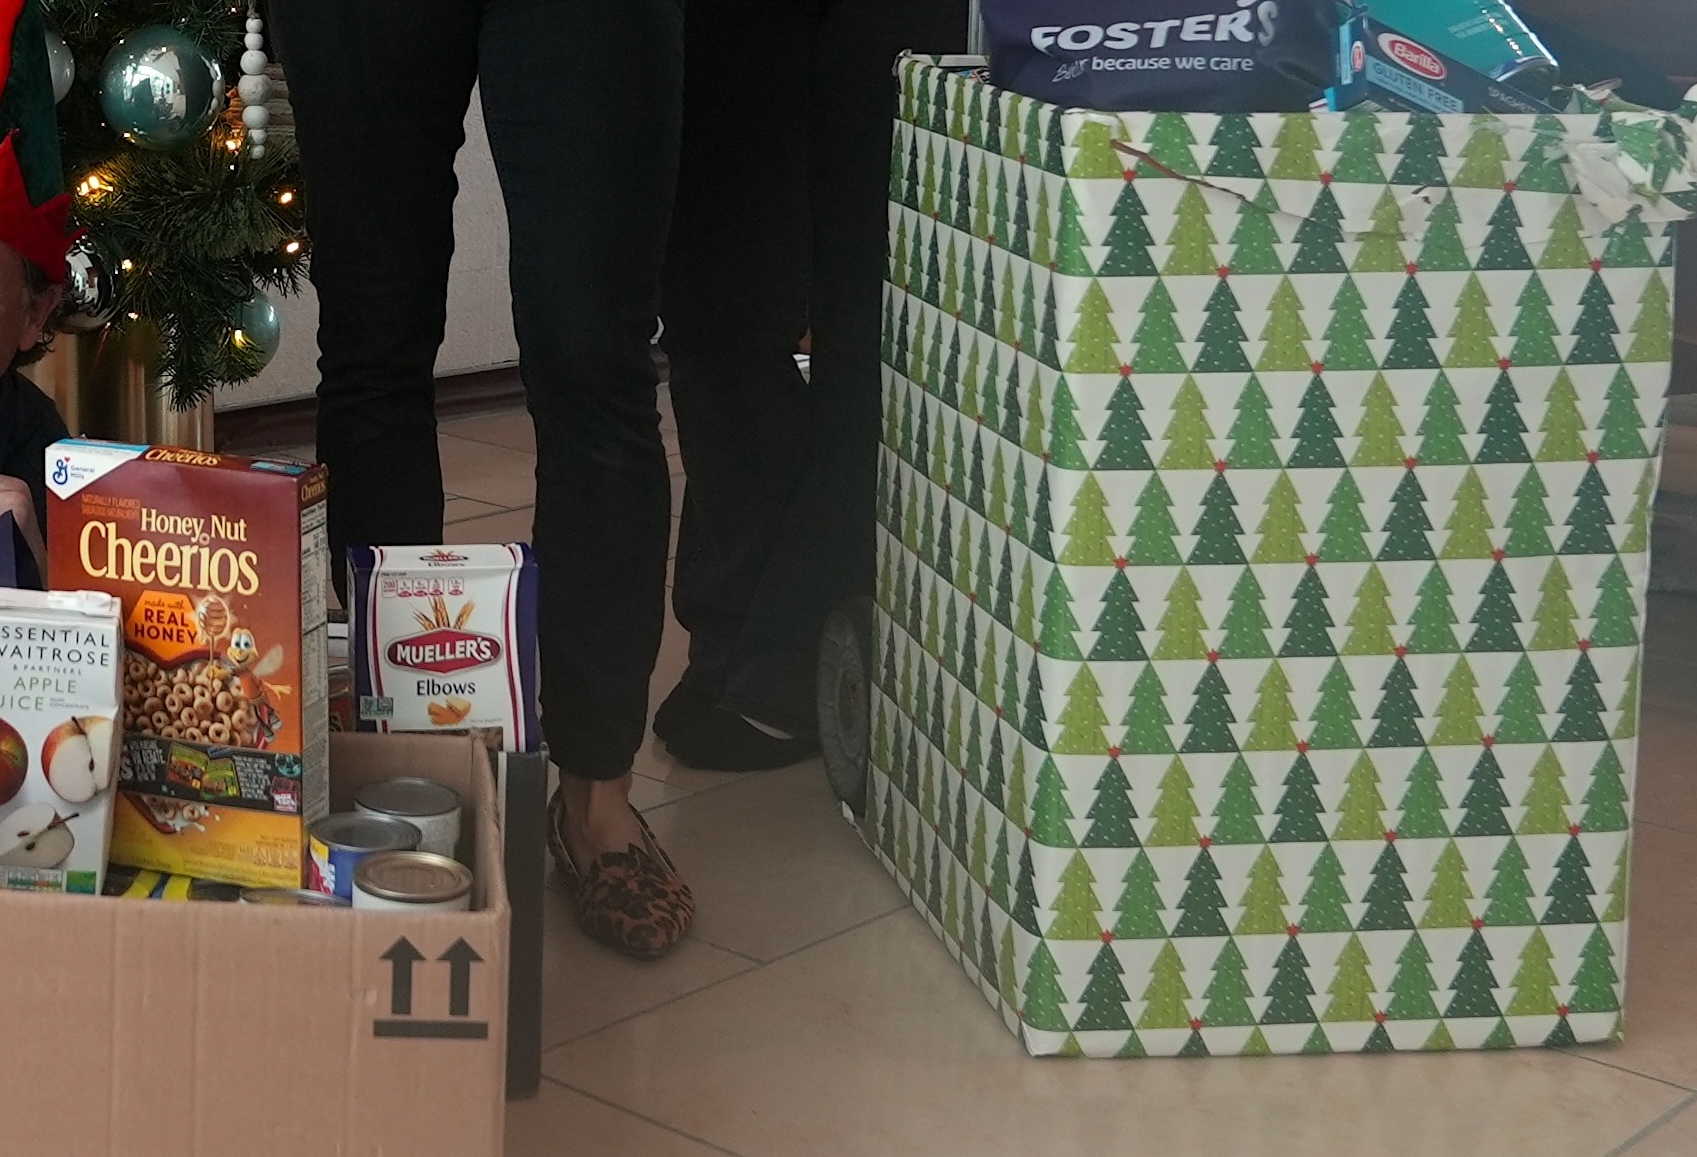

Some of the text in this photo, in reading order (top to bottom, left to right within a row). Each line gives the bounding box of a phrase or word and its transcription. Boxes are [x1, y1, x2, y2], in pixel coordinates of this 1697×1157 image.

[1092, 56, 1170, 71] because
[1175, 57, 1205, 70] we
[1210, 57, 1255, 71] care
[1394, 44, 1441, 72] Barilla
[1373, 61, 1423, 96] GLUTEN
[1427, 90, 1458, 110] FREE
[144, 448, 221, 466] Cheerios
[141, 507, 204, 542] Honey
[210, 514, 248, 542] Nut
[80, 520, 260, 596] Cheerios
[144, 598, 186, 610] made with
[143, 608, 189, 628] REAL
[134, 621, 198, 645] HONEY
[397, 637, 492, 666] MUELLER'S
[23, 664, 82, 675] PARTNERS
[13, 676, 77, 693] APPLE
[416, 679, 476, 696] Elbows
